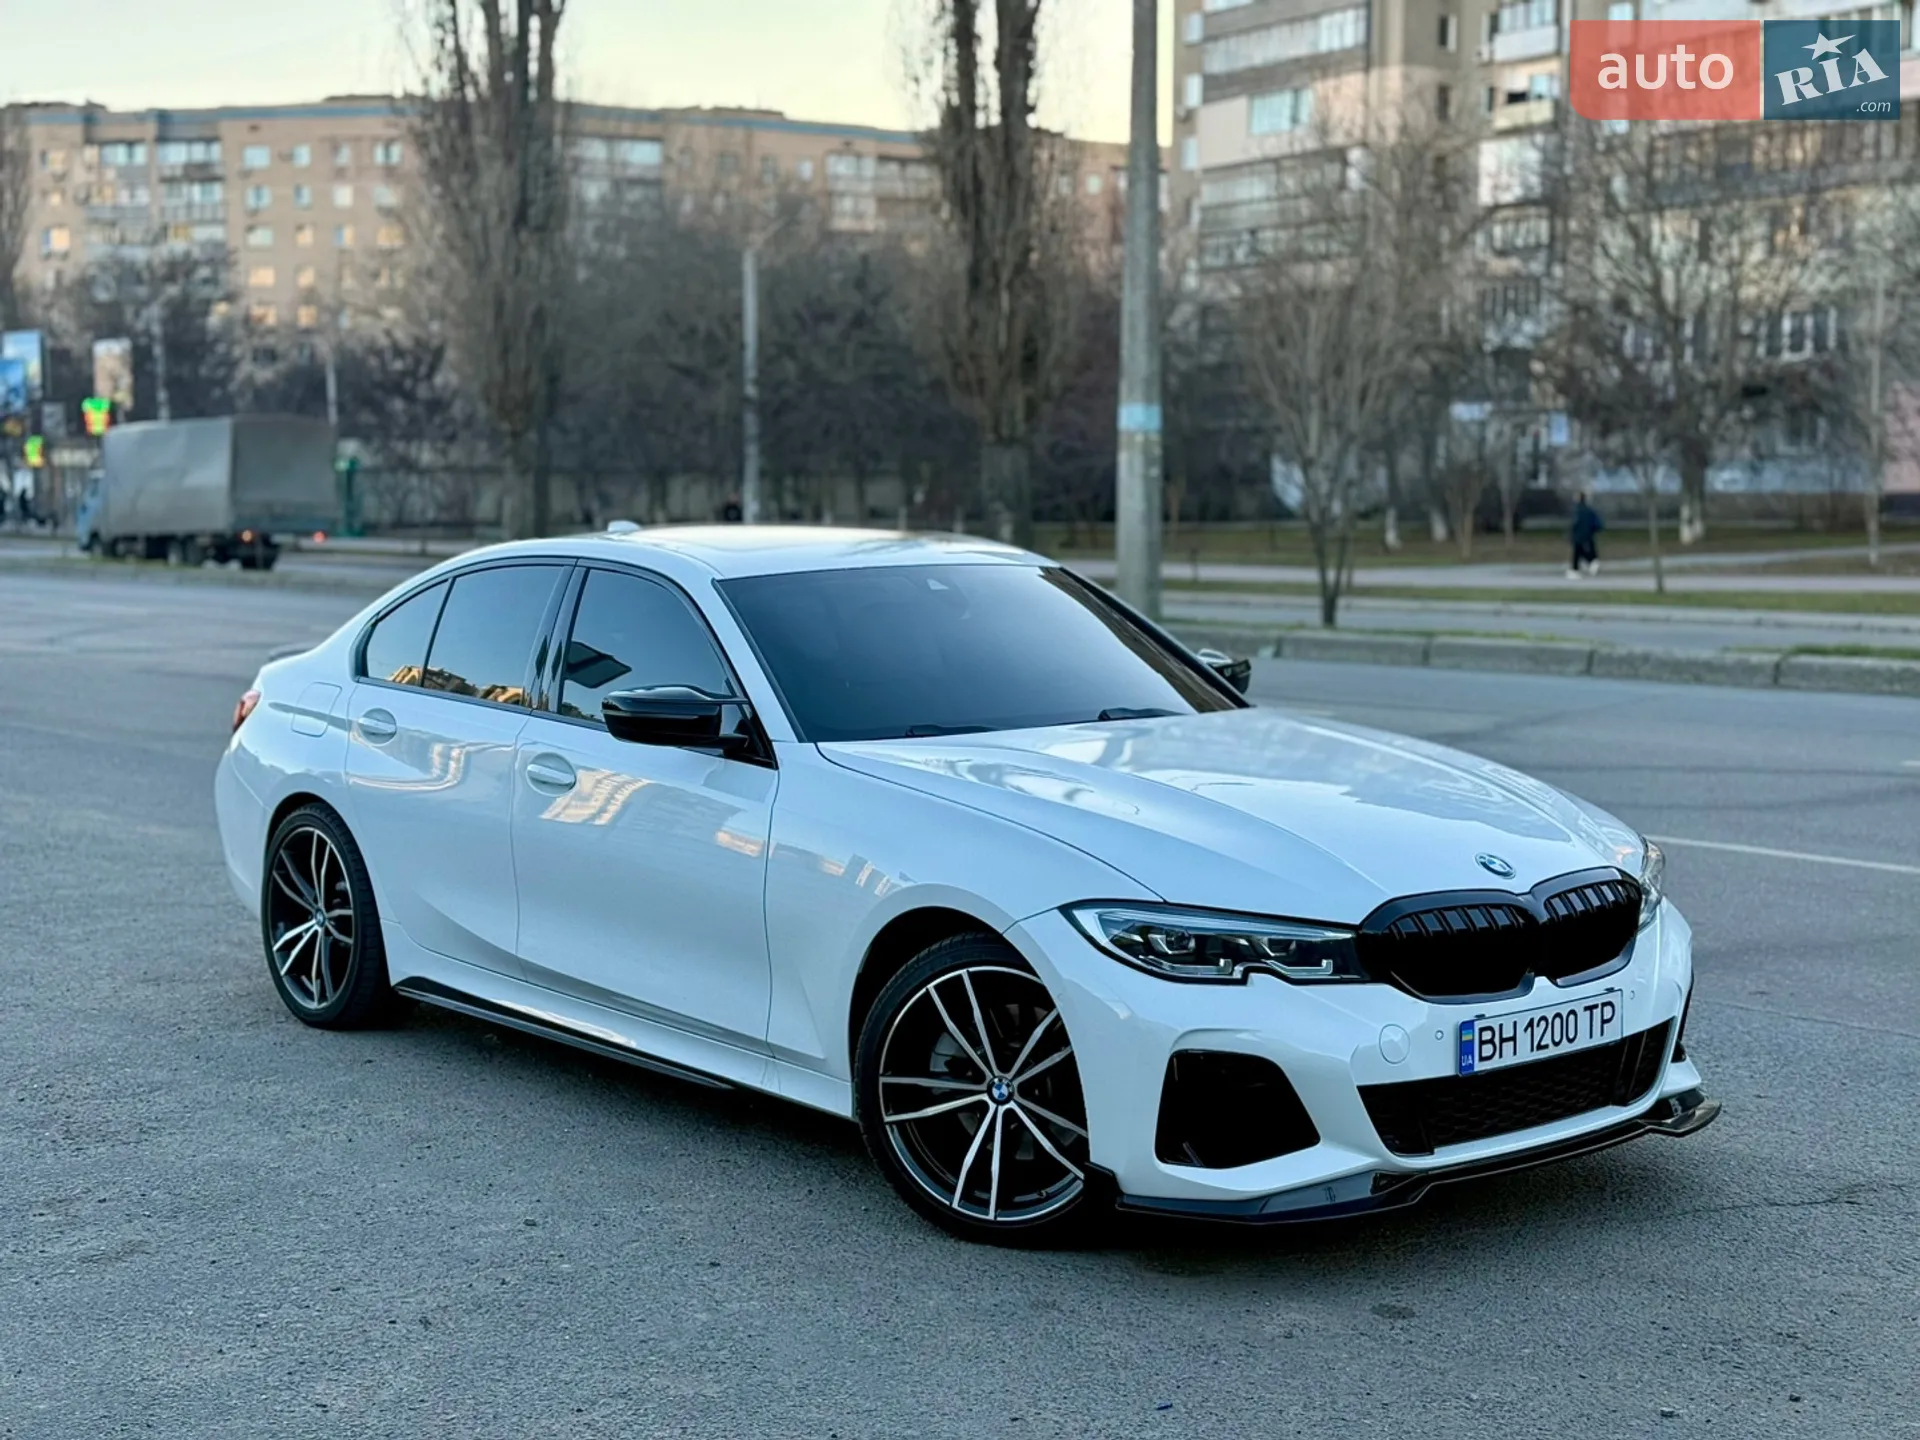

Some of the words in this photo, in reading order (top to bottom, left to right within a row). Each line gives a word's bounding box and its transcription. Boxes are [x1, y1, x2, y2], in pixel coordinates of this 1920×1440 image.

[1478, 1020, 1517, 1062] BH
[1523, 1009, 1578, 1052] 1200
[1583, 1000, 1615, 1039] TP
[1461, 1055, 1473, 1067] UA
